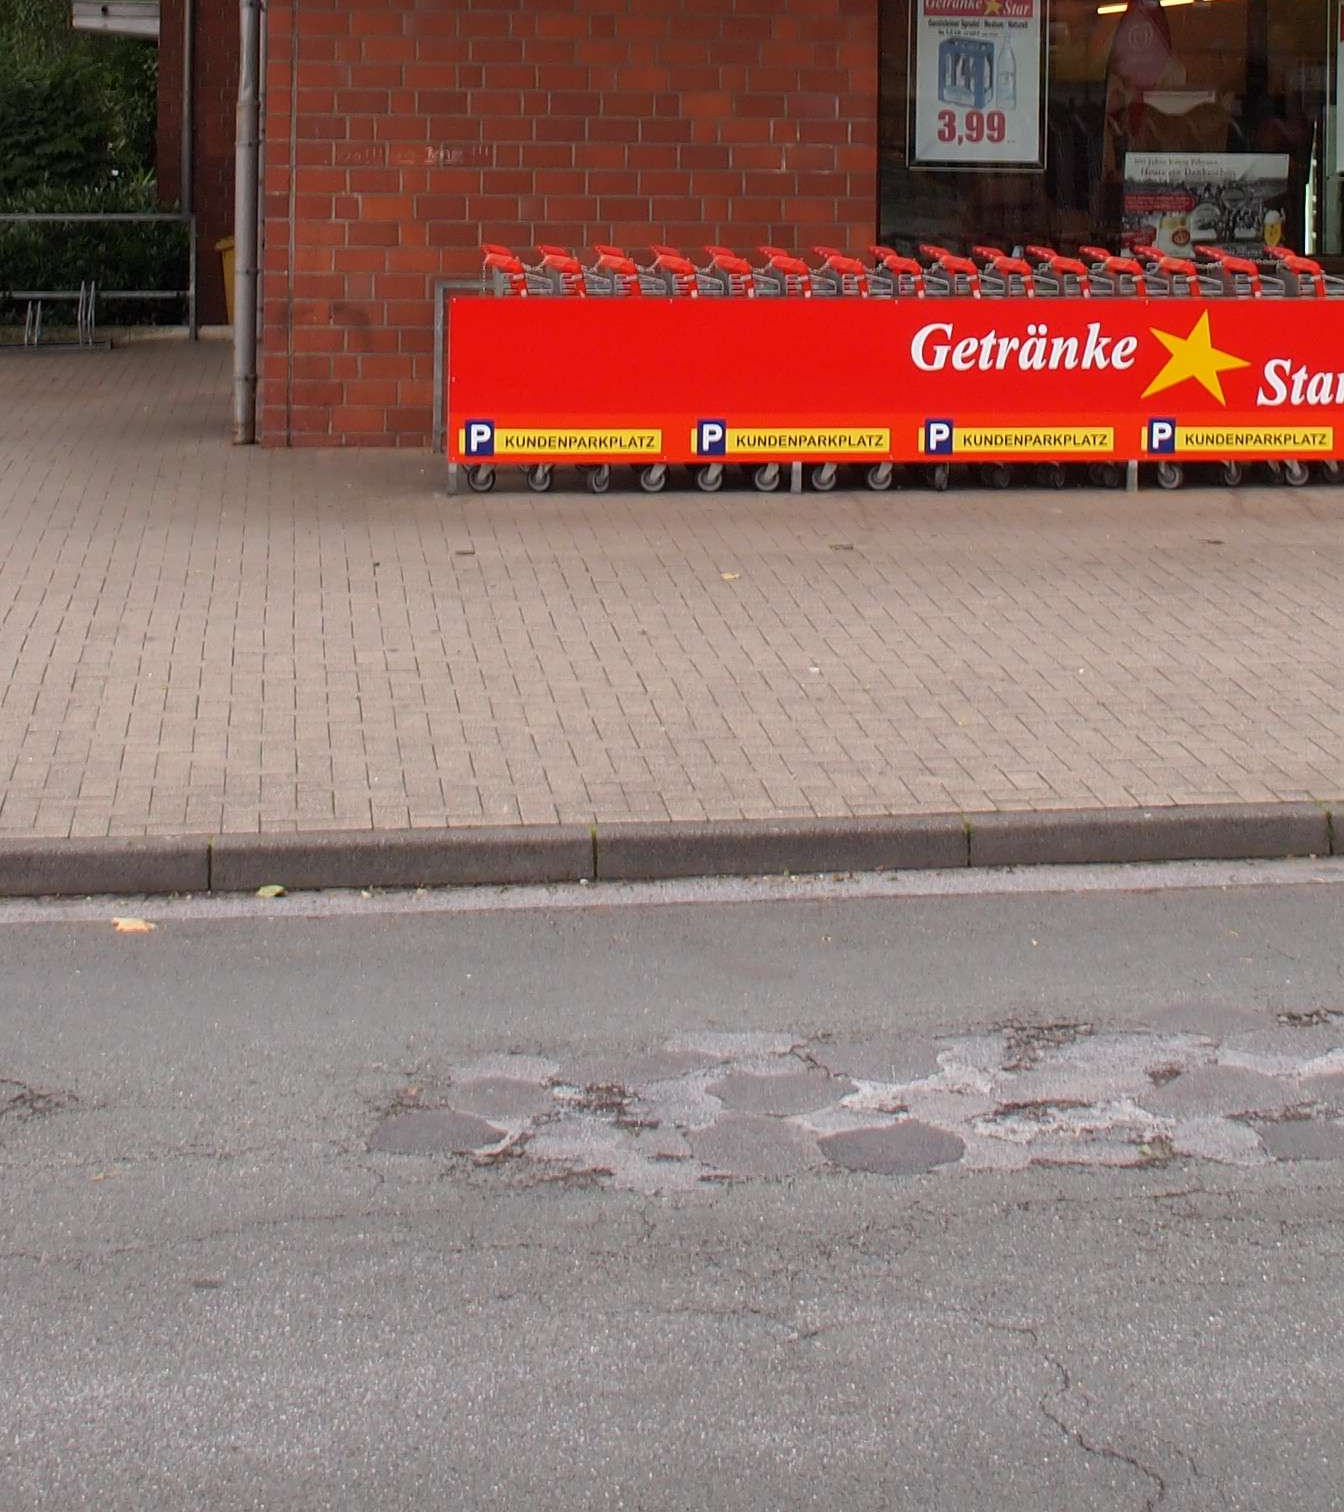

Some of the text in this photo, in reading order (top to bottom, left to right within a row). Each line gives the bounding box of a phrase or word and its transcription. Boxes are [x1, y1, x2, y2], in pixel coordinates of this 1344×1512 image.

[1003, 0, 1033, 16] Star
[937, 109, 1006, 146] 3,99
[910, 322, 1138, 372] Getränke
[471, 424, 655, 451] P KUNDENPARKPLATZ
[703, 423, 883, 450] P KUNDENPARKPLATZ
[930, 423, 1108, 450] P KUNDENPARKPLATZ
[1153, 422, 1327, 449] P KUNDENPARKPLATZ
